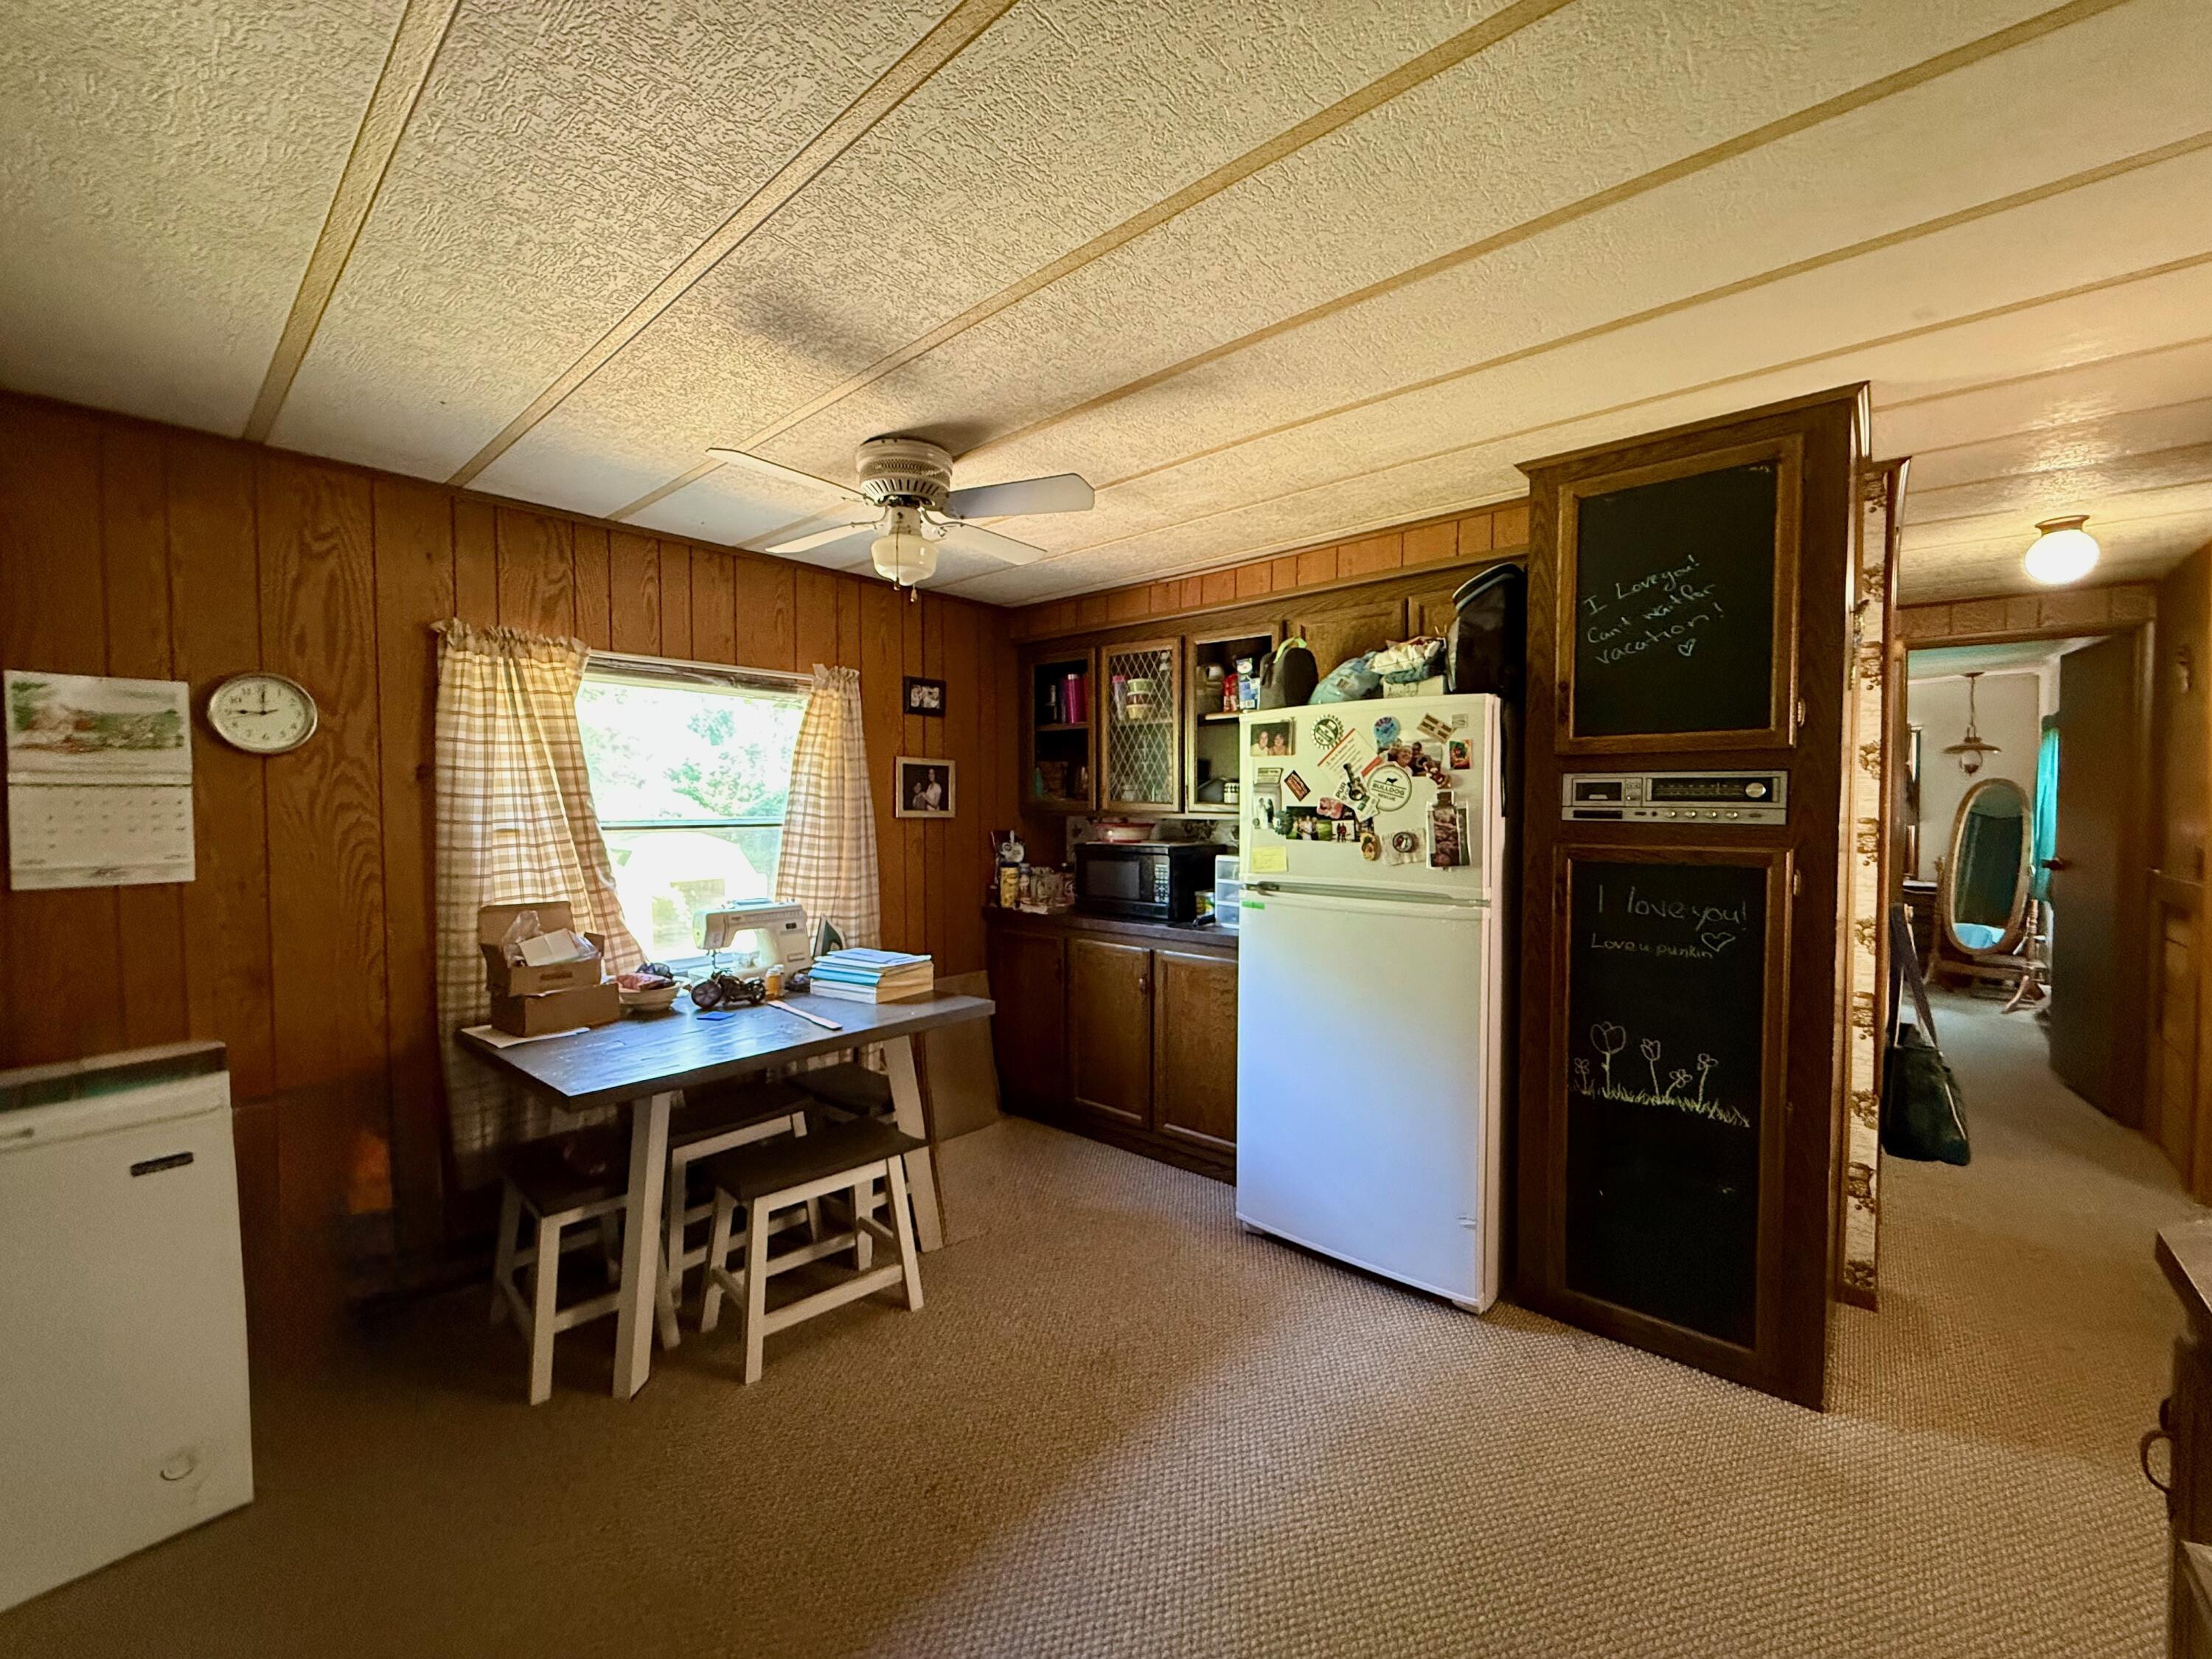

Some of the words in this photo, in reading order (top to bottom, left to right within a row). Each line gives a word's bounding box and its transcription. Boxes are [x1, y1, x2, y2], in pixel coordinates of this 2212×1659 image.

[1583, 594, 1609, 616] I
[1615, 574, 1659, 600] Love
[1596, 602, 1725, 664] vacation!
[1371, 782, 1405, 796] BULLDOG
[1598, 884, 1604, 914] I
[1627, 886, 1686, 919] love
[1691, 900, 1747, 931] you!
